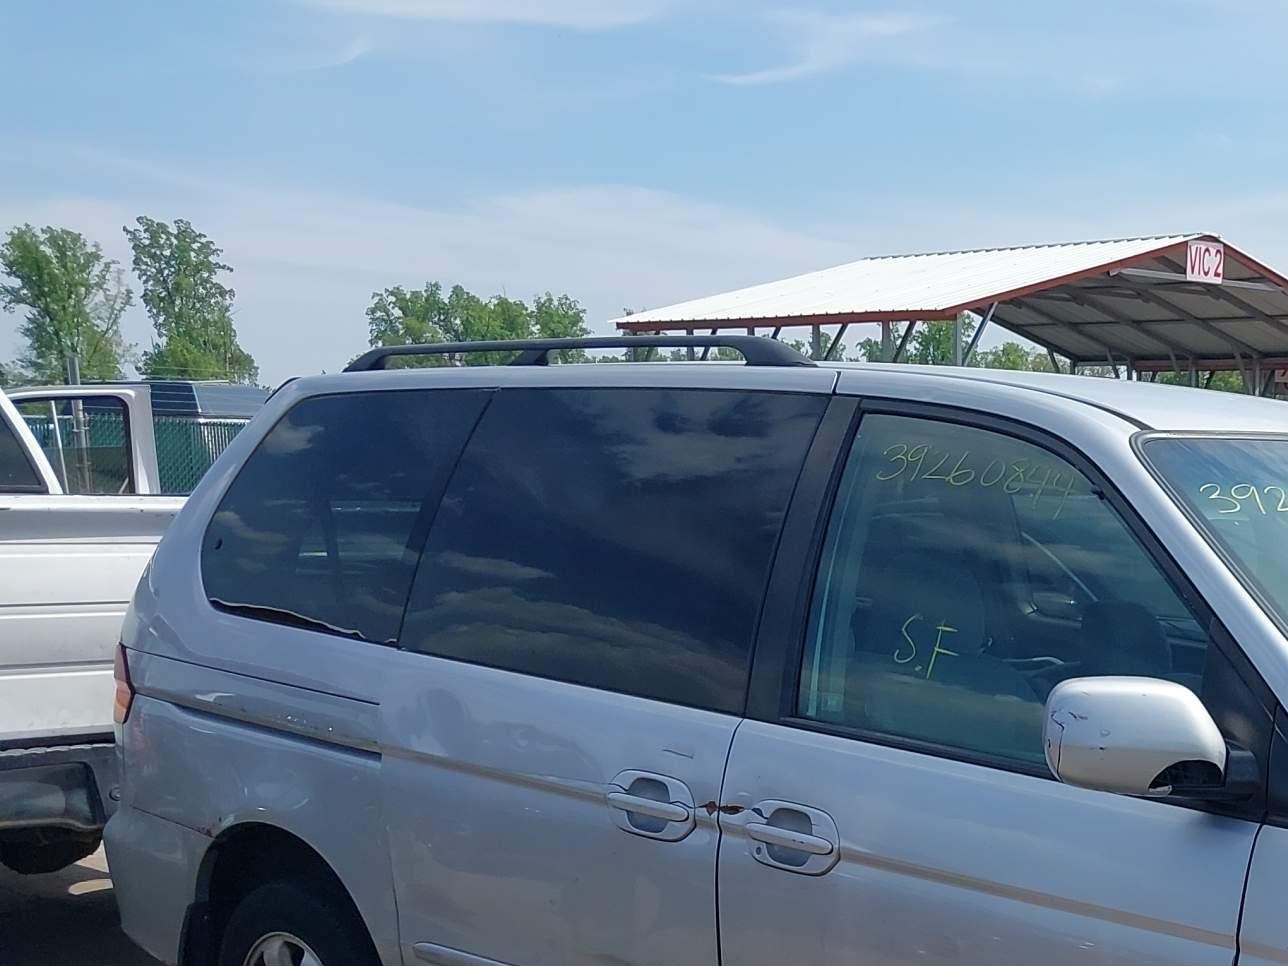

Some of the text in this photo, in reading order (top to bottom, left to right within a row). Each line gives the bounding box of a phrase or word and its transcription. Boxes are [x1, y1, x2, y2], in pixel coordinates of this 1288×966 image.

[1189, 245, 1223, 278] VIC 2
[875, 443, 1075, 521] 39260844
